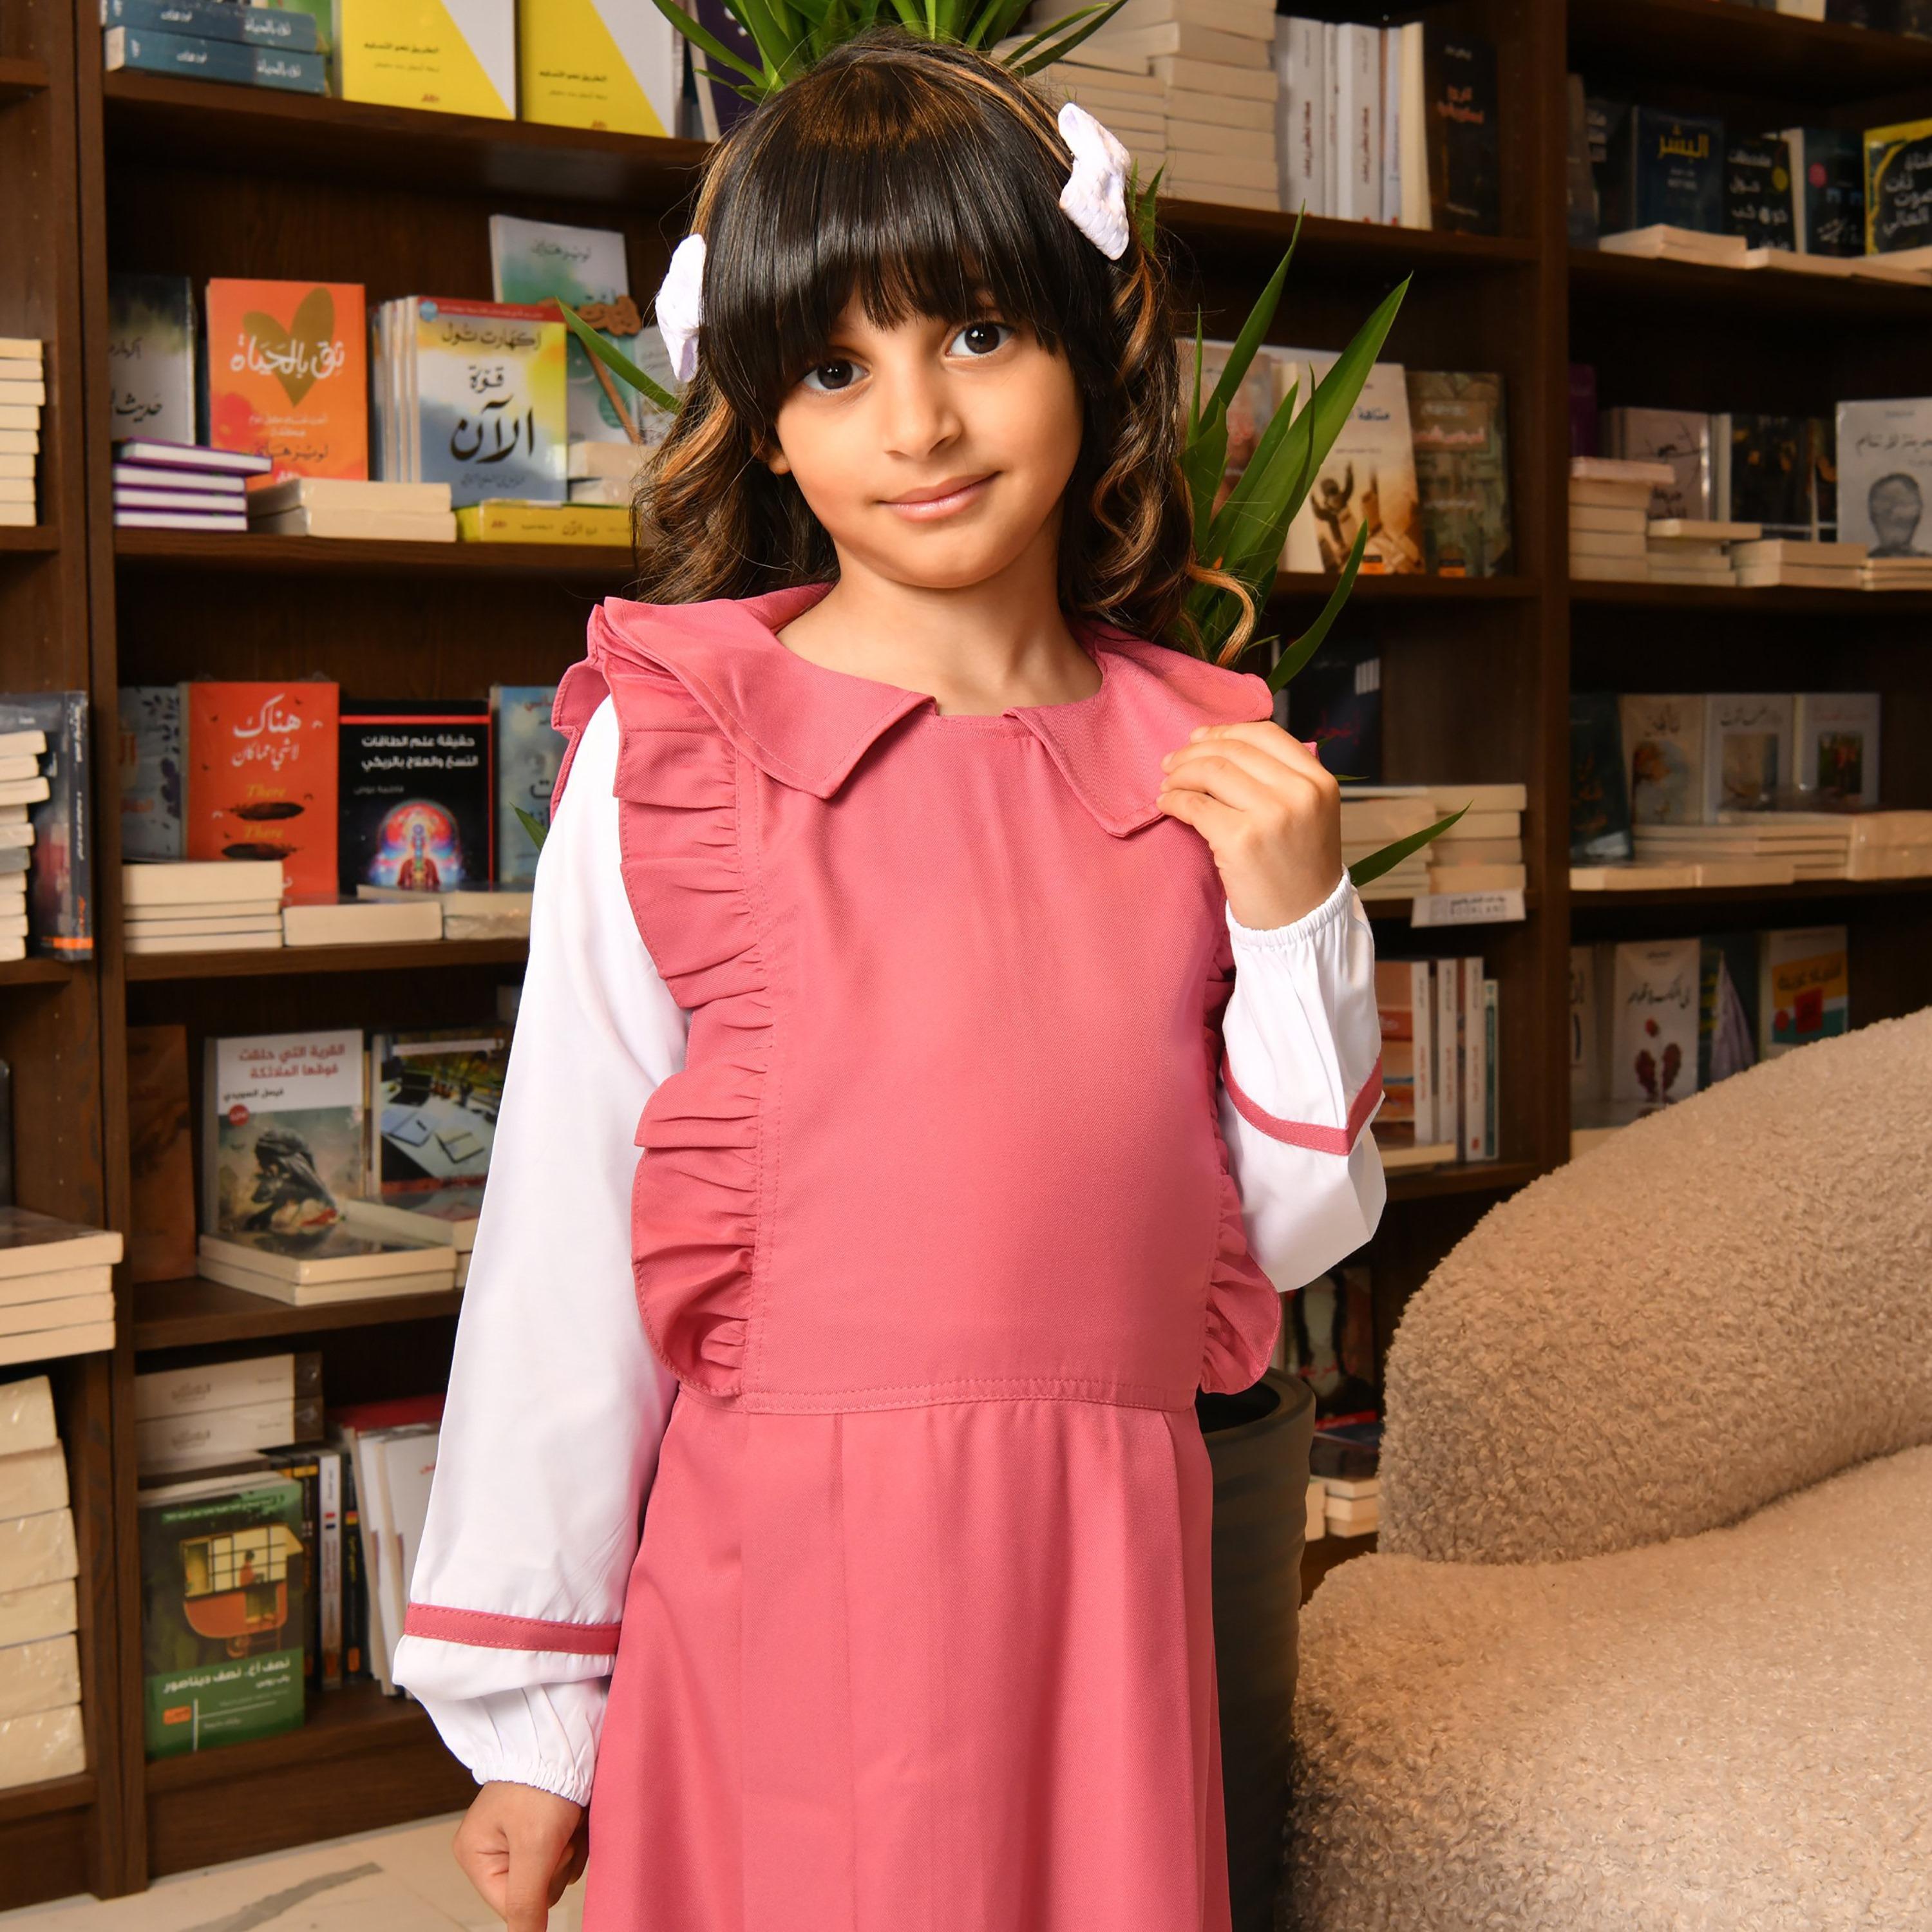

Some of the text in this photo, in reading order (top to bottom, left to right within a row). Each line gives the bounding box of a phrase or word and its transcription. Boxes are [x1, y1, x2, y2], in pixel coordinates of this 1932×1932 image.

[450, 393, 535, 464] الآن
[232, 694, 302, 738] هناك
[410, 735, 435, 750] علم
[436, 734, 475, 750] حقيقة
[247, 784, 287, 798] There
[278, 1046, 307, 1063] التي
[309, 1043, 345, 1059] القرية
[262, 1656, 290, 1672] نصف
[213, 1665, 242, 1682] نصف
